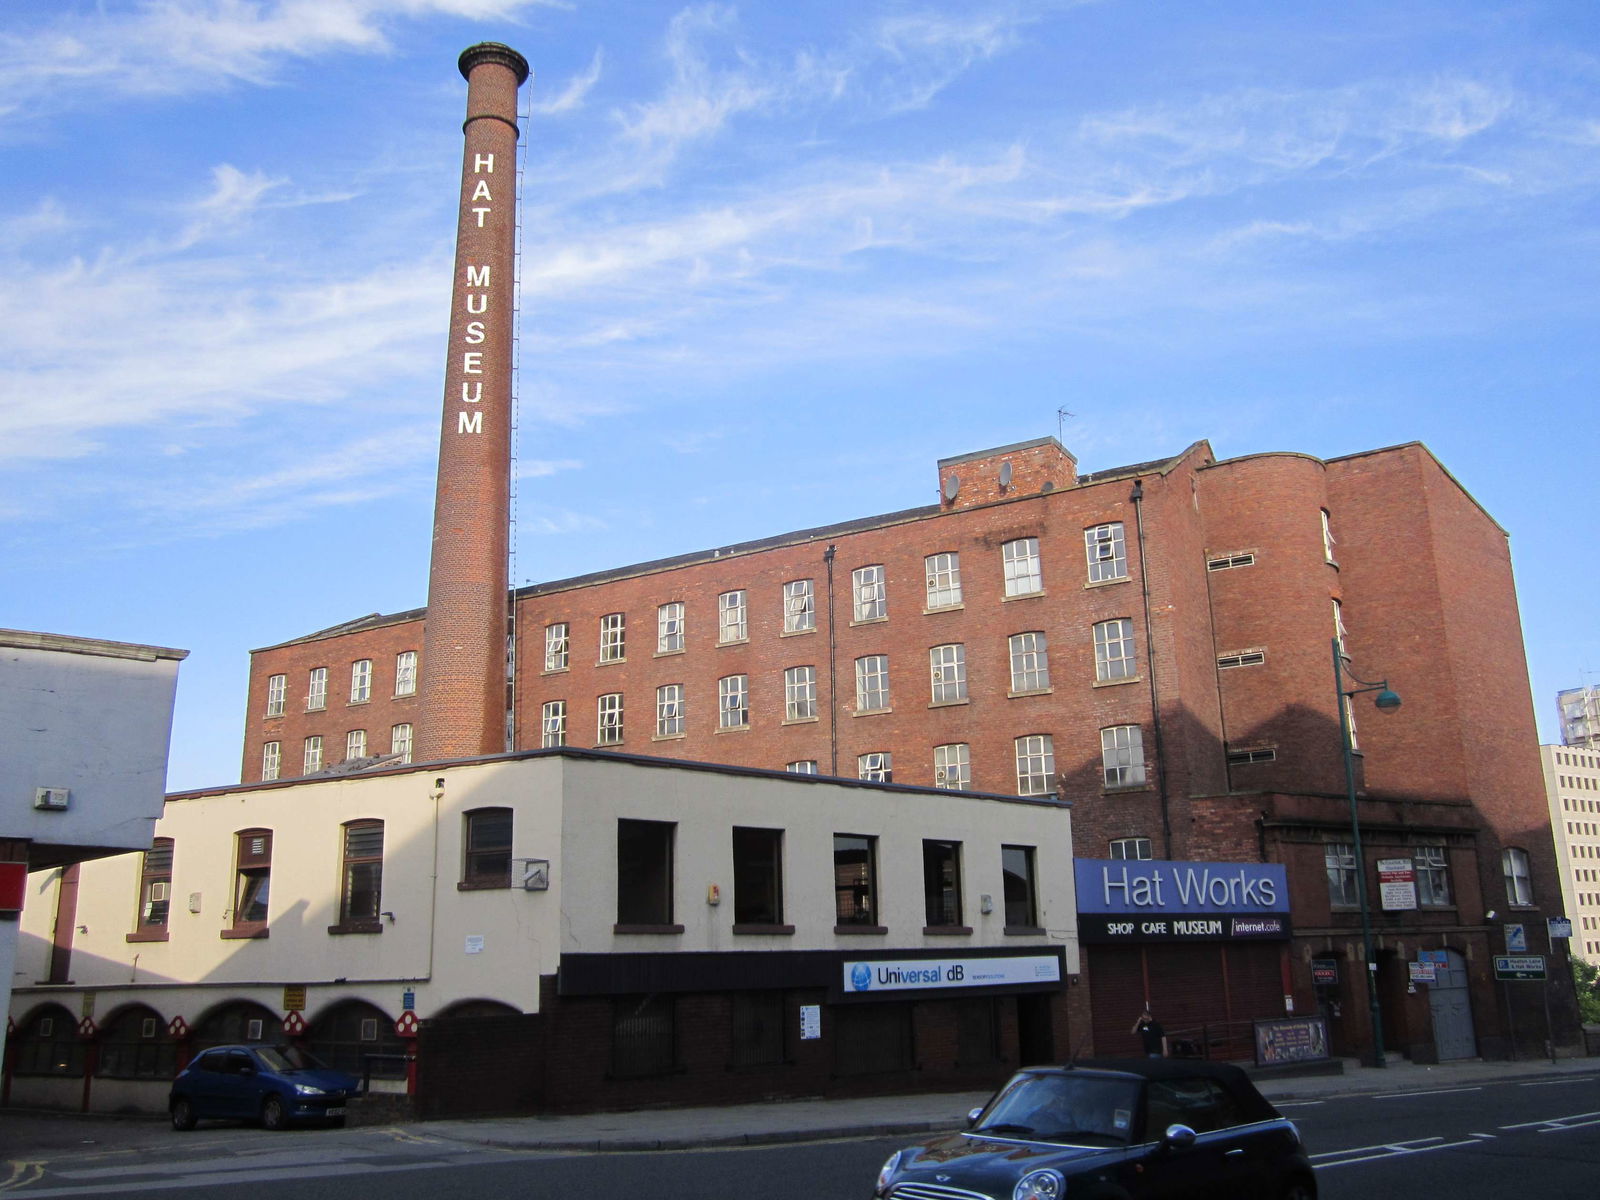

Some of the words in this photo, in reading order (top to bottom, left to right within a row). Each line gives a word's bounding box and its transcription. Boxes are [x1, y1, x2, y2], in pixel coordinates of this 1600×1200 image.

[472, 153, 495, 228] HAT
[457, 265, 491, 434] MUSEUM
[1103, 866, 1166, 906] Hat
[1173, 867, 1277, 906] Works
[1107, 922, 1135, 935] SHOP
[1141, 922, 1167, 935] CAFE
[1173, 920, 1223, 935] MUSEUM
[877, 965, 942, 985] Universal
[946, 965, 965, 982] dB
